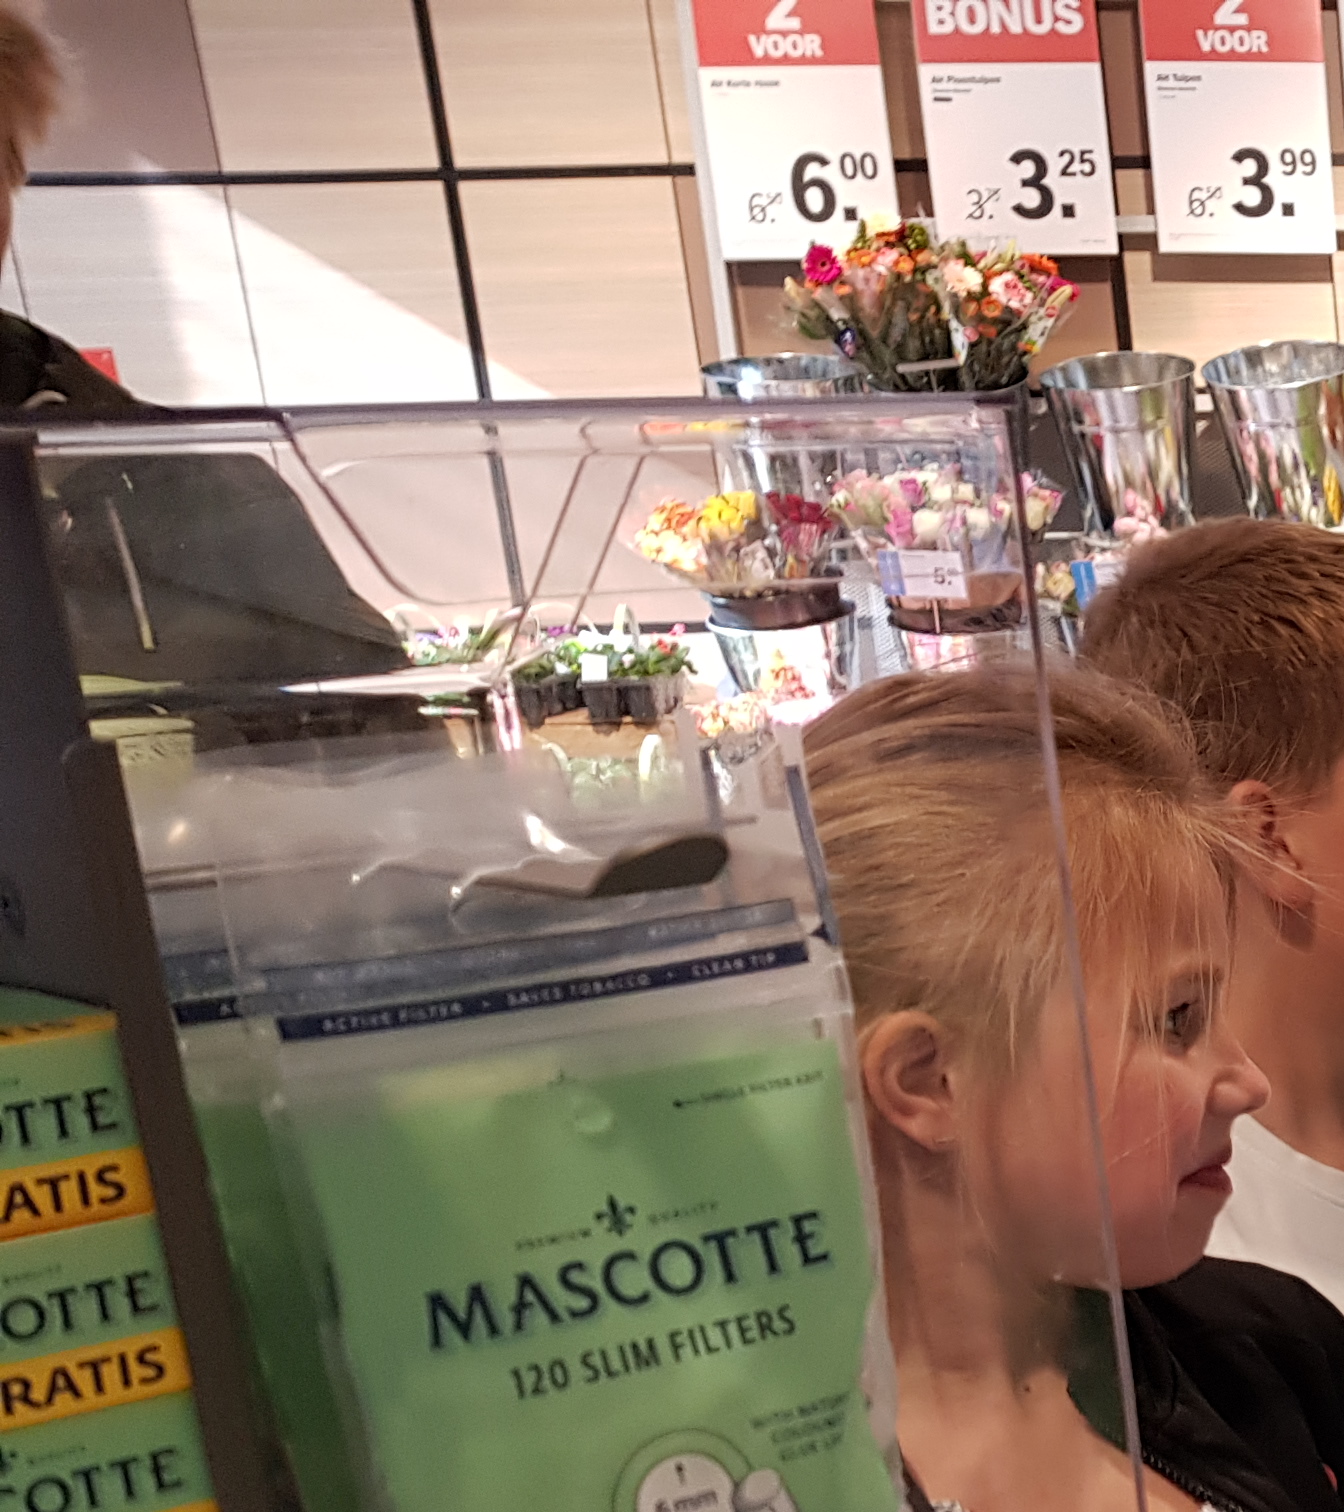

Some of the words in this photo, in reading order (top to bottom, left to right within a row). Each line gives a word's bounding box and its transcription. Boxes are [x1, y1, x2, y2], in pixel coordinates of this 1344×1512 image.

[925, 0, 1084, 36] BONUS
[1195, 29, 1269, 53] VOOR
[748, 33, 824, 58] VOOR
[0, 1087, 119, 1149] TTE
[424, 1209, 832, 1351] MASCOTTE
[509, 1358, 571, 1401] 120
[580, 1336, 662, 1384] SLIM
[668, 1303, 797, 1364] FILTERS
